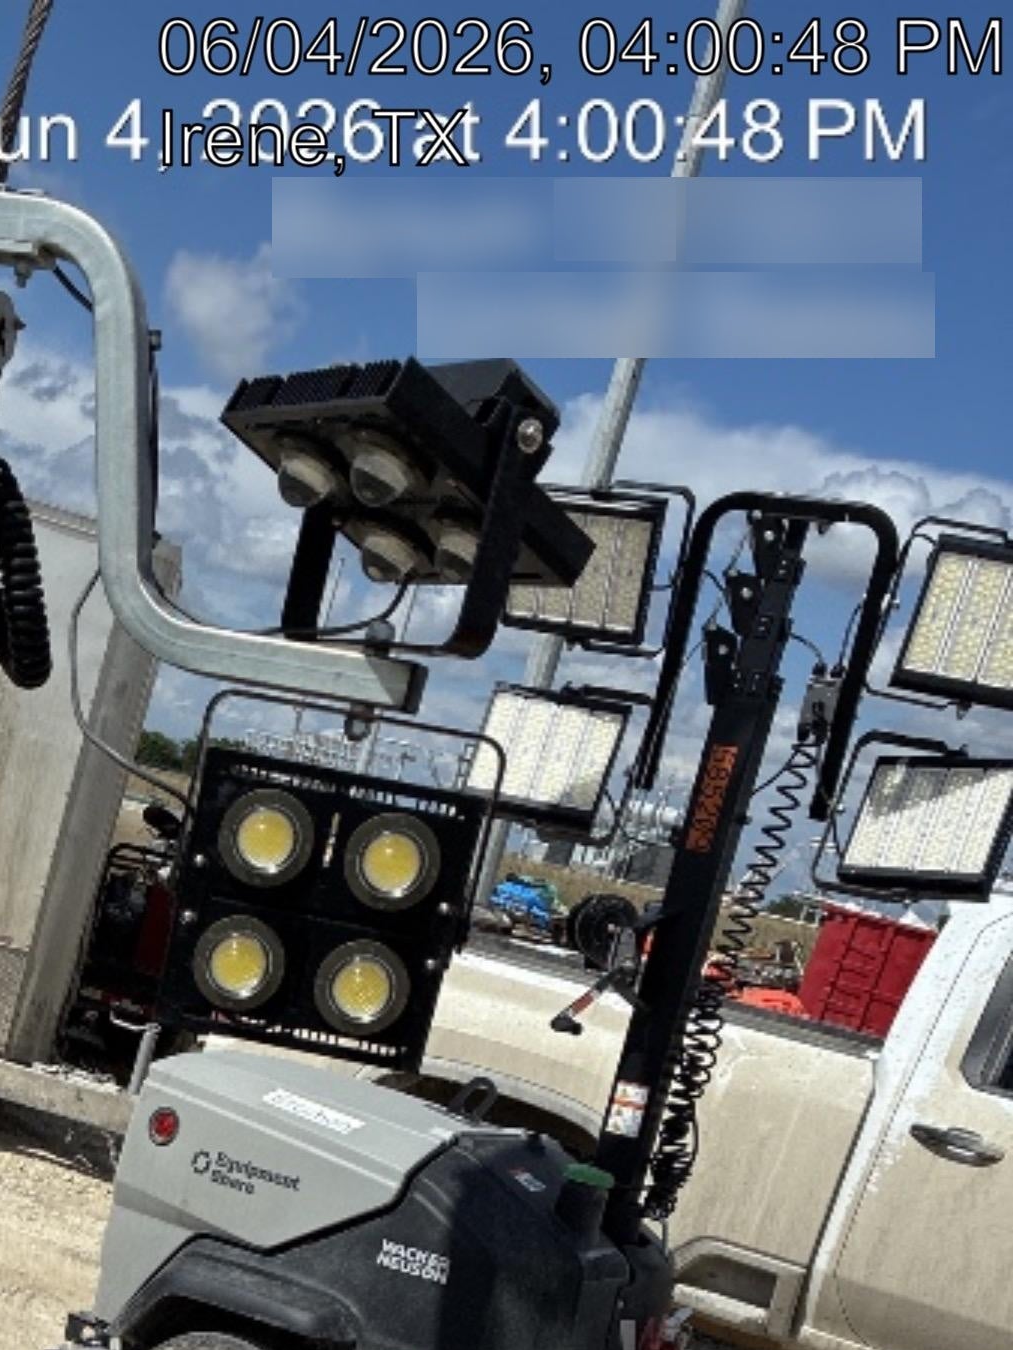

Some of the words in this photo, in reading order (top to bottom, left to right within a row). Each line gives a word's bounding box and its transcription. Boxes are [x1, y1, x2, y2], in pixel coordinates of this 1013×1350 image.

[215, 1152, 300, 1192] Equipment
[376, 1252, 447, 1285] NEUSON
[382, 1239, 449, 1275] WACKER
